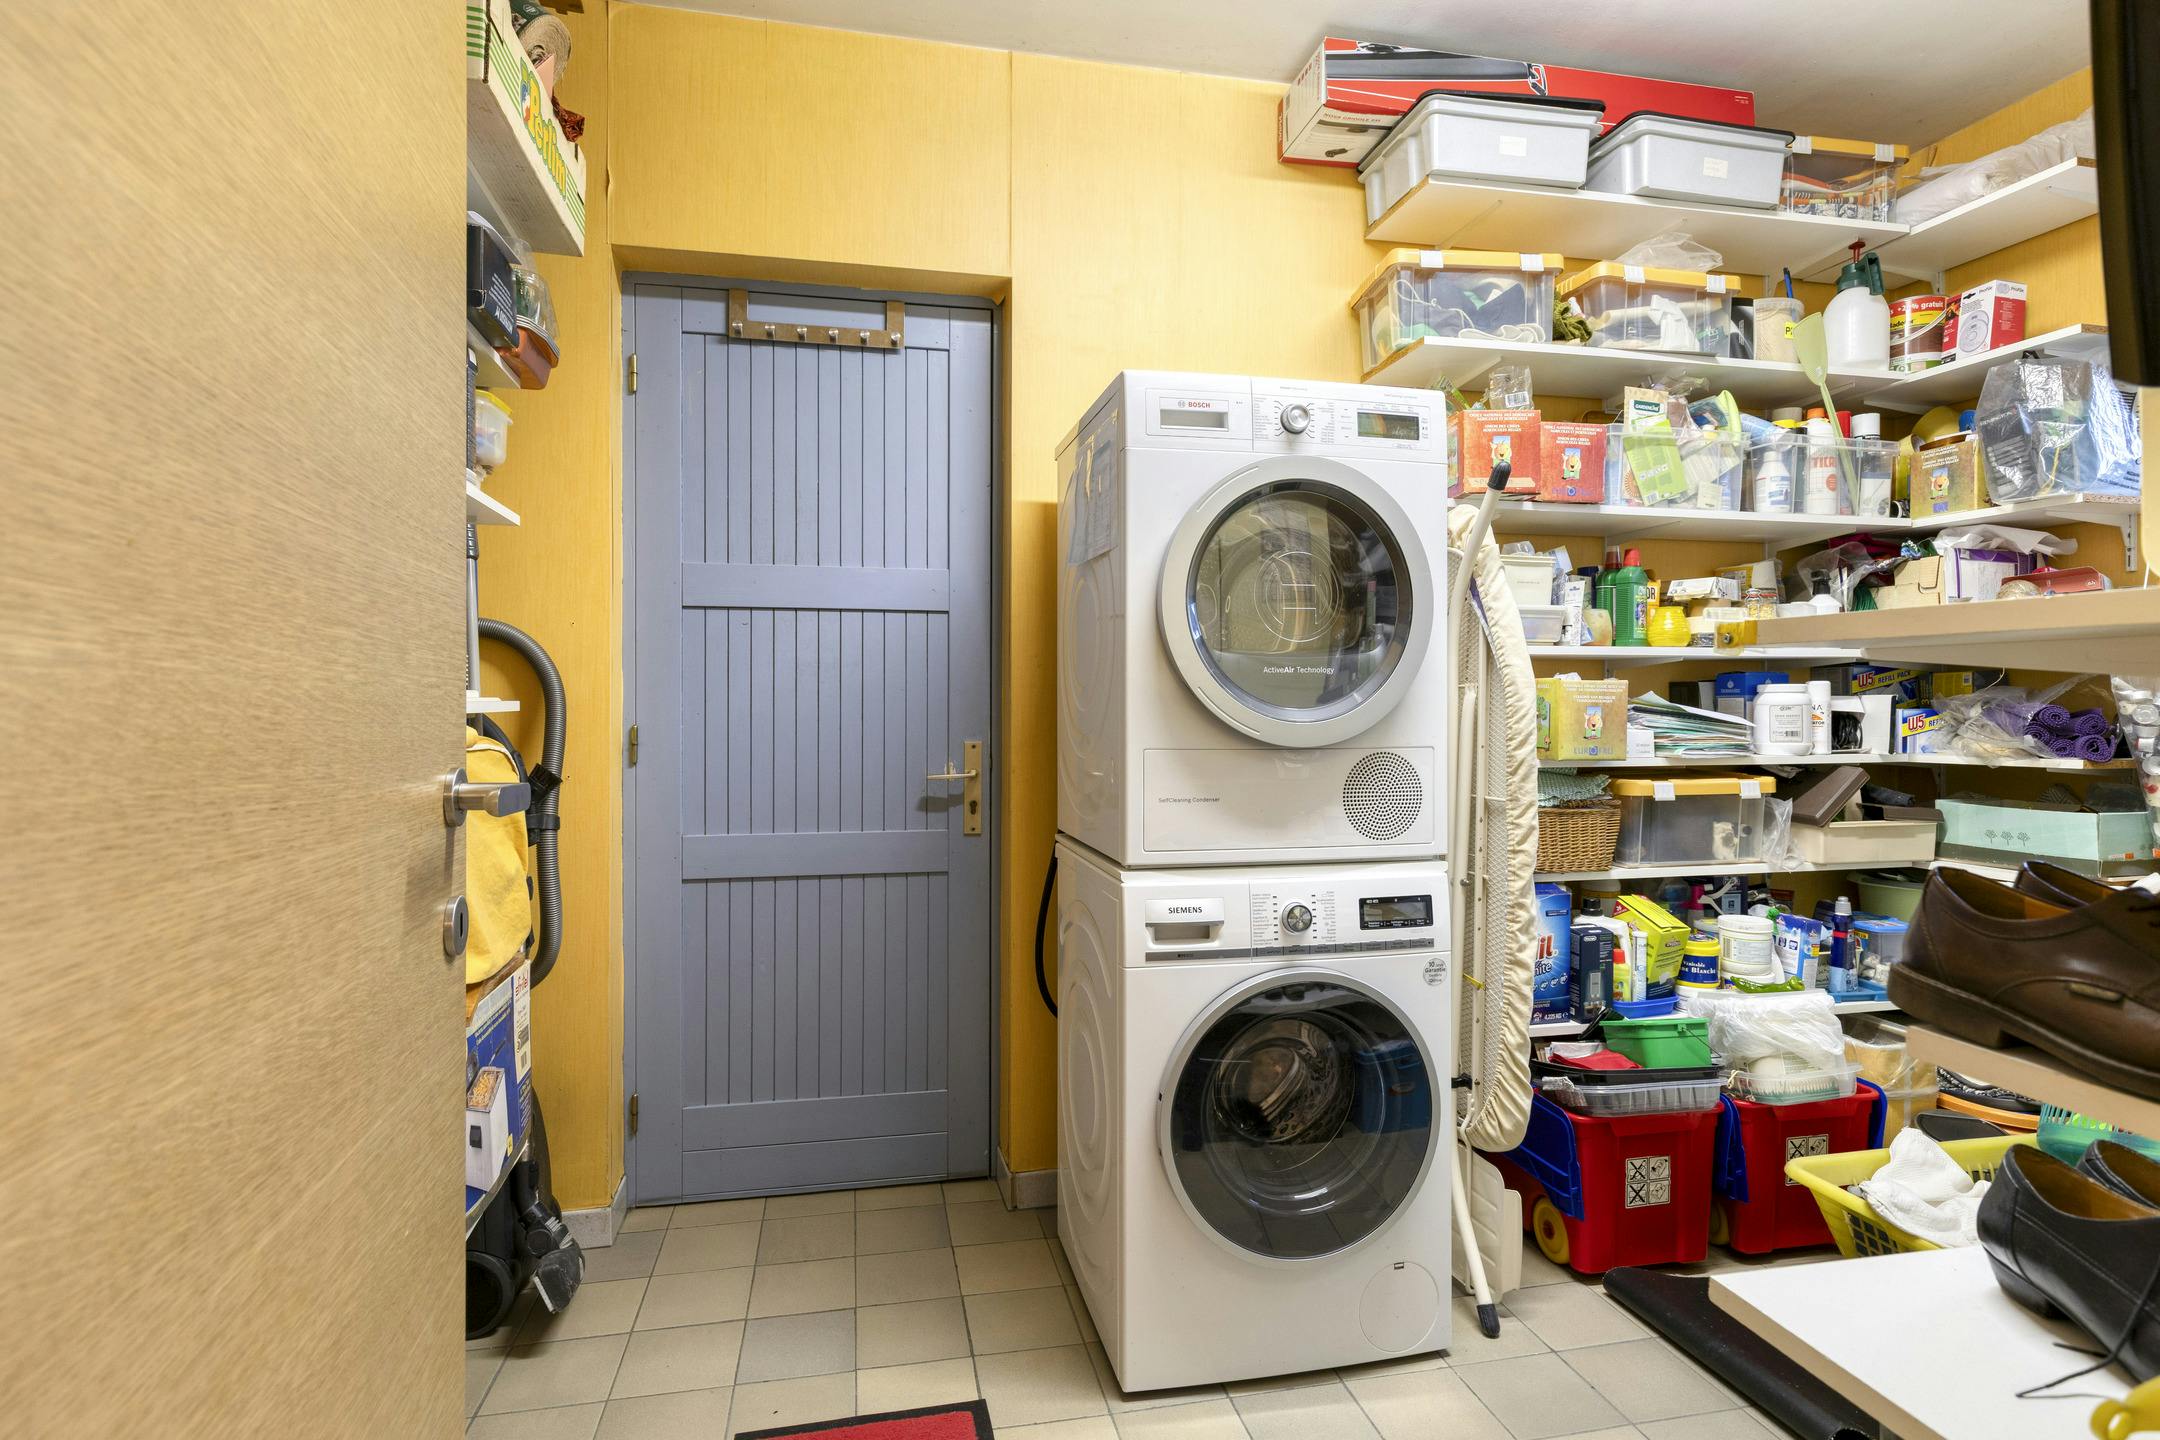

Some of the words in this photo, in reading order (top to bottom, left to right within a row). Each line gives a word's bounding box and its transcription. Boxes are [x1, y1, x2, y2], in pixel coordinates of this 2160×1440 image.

[527, 70, 567, 202] Perlim
[1188, 401, 1211, 409] BOSCH
[1263, 666, 1295, 674] ActiveAir
[1296, 666, 1335, 675] Technology
[1857, 671, 1875, 688] W5
[1878, 674, 1896, 684] REFILL
[1907, 713, 1926, 732] W5
[1168, 906, 1203, 914] SIEMENS
